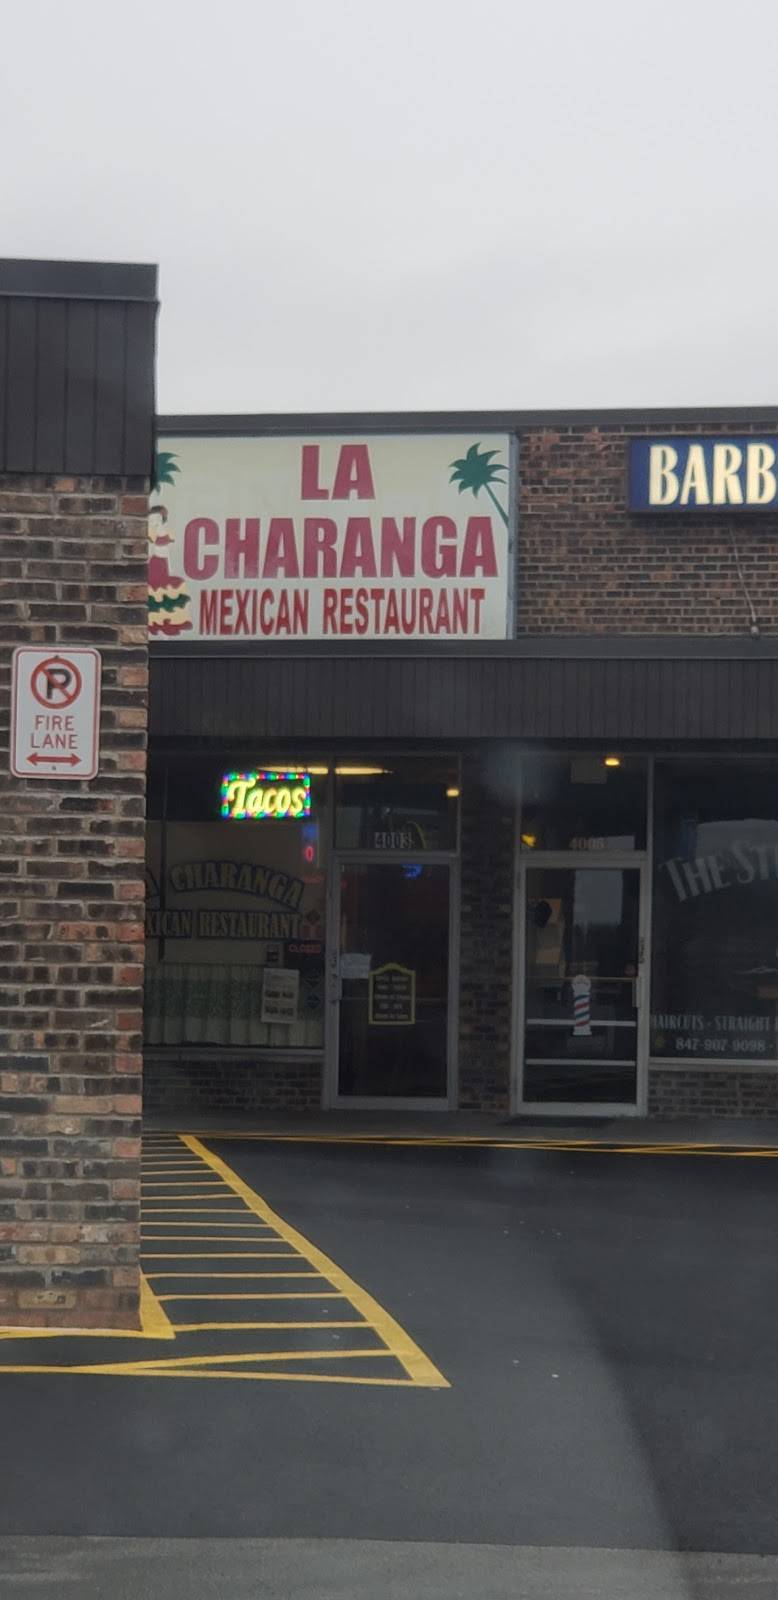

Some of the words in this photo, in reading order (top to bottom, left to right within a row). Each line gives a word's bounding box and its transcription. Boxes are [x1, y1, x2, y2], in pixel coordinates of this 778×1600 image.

[300, 444, 376, 501] LA
[649, 443, 777, 505] BARB
[183, 516, 498, 581] CHARANGA
[199, 588, 310, 636] MEXICAN
[322, 587, 486, 635] RESTAURANT
[30, 733, 79, 750] LANE
[34, 714, 75, 732] FIRE
[225, 778, 308, 816] Tacos
[170, 860, 305, 912] CHARANGA
[199, 909, 302, 940] RESTAURANT
